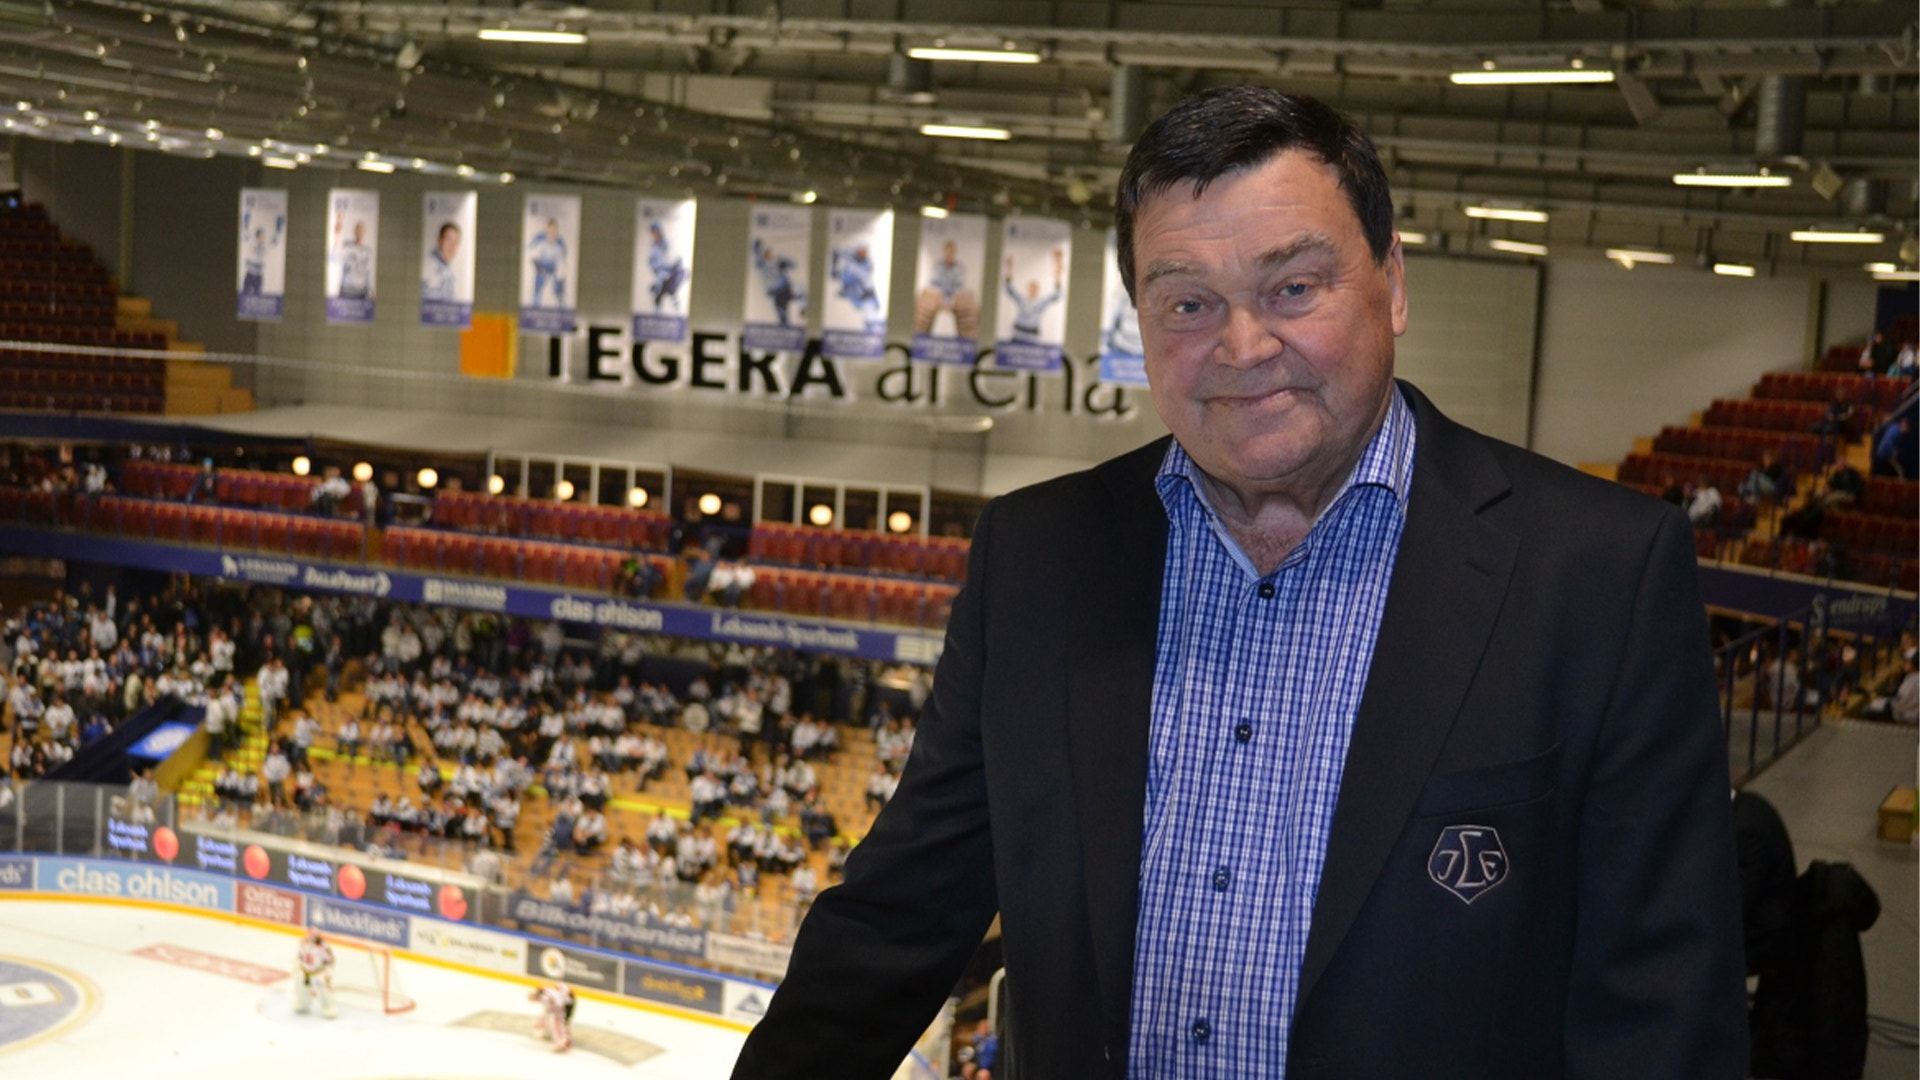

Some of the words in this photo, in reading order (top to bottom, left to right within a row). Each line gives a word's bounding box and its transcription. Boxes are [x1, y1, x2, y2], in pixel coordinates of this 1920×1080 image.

[546, 322, 845, 398] TEGERA
[876, 342, 1135, 417] arena
[551, 595, 594, 623] clas
[596, 601, 663, 632] ohlson
[57, 863, 121, 894] clas
[127, 868, 219, 907] ohlson
[515, 900, 704, 953] Bilkompaniet
